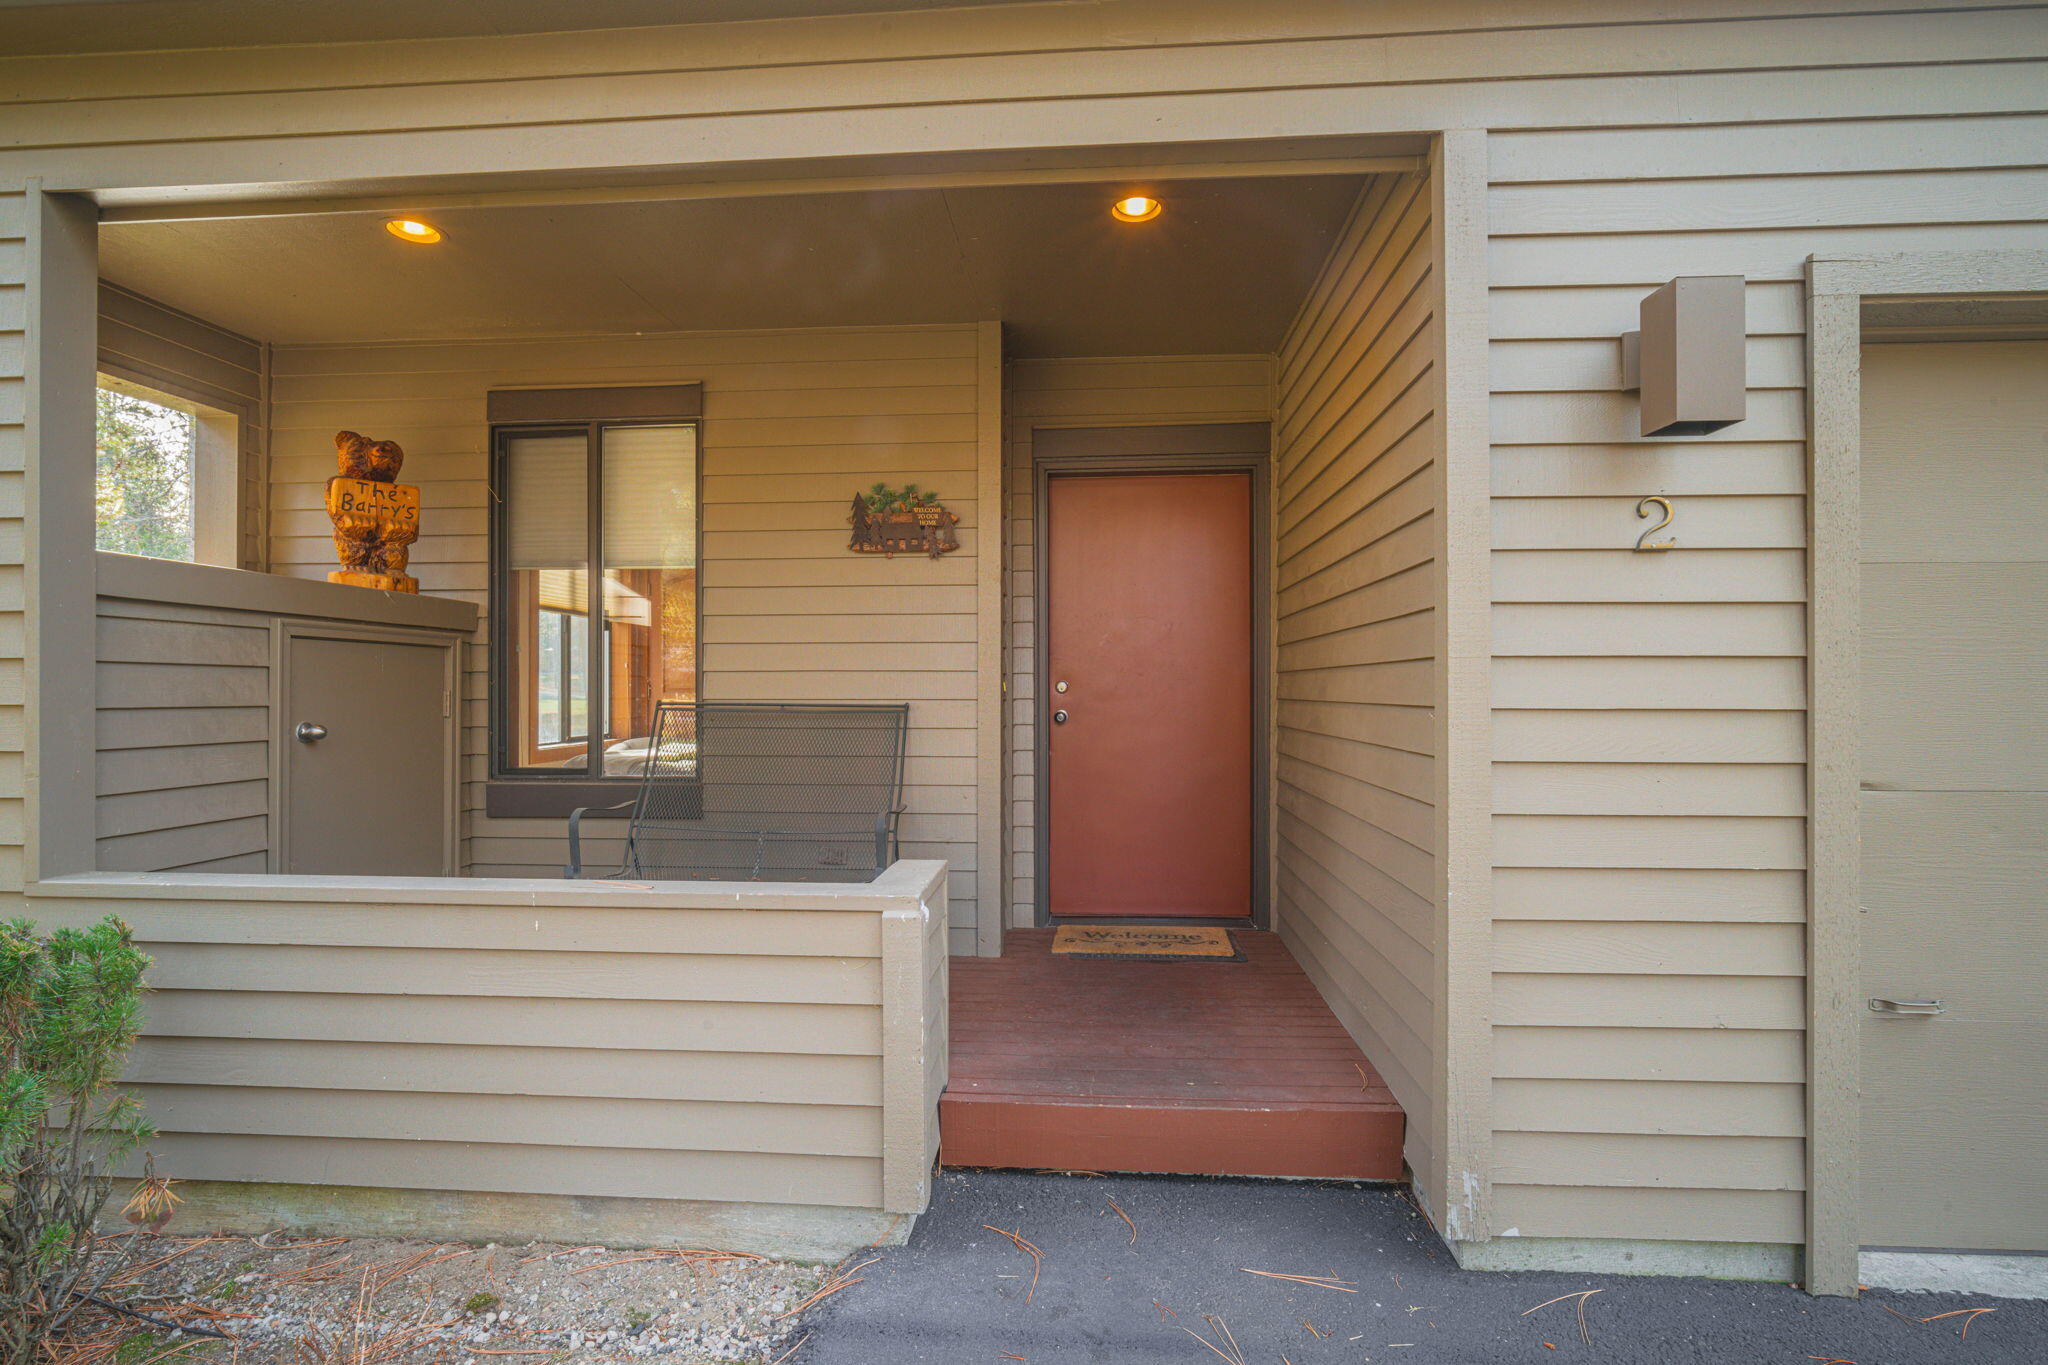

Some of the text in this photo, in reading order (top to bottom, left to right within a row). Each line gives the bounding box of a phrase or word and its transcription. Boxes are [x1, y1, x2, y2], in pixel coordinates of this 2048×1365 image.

[356, 481, 399, 502] The
[340, 493, 416, 520] Barry's
[1635, 495, 1676, 552] 2
[1083, 930, 1203, 941] Welcome
